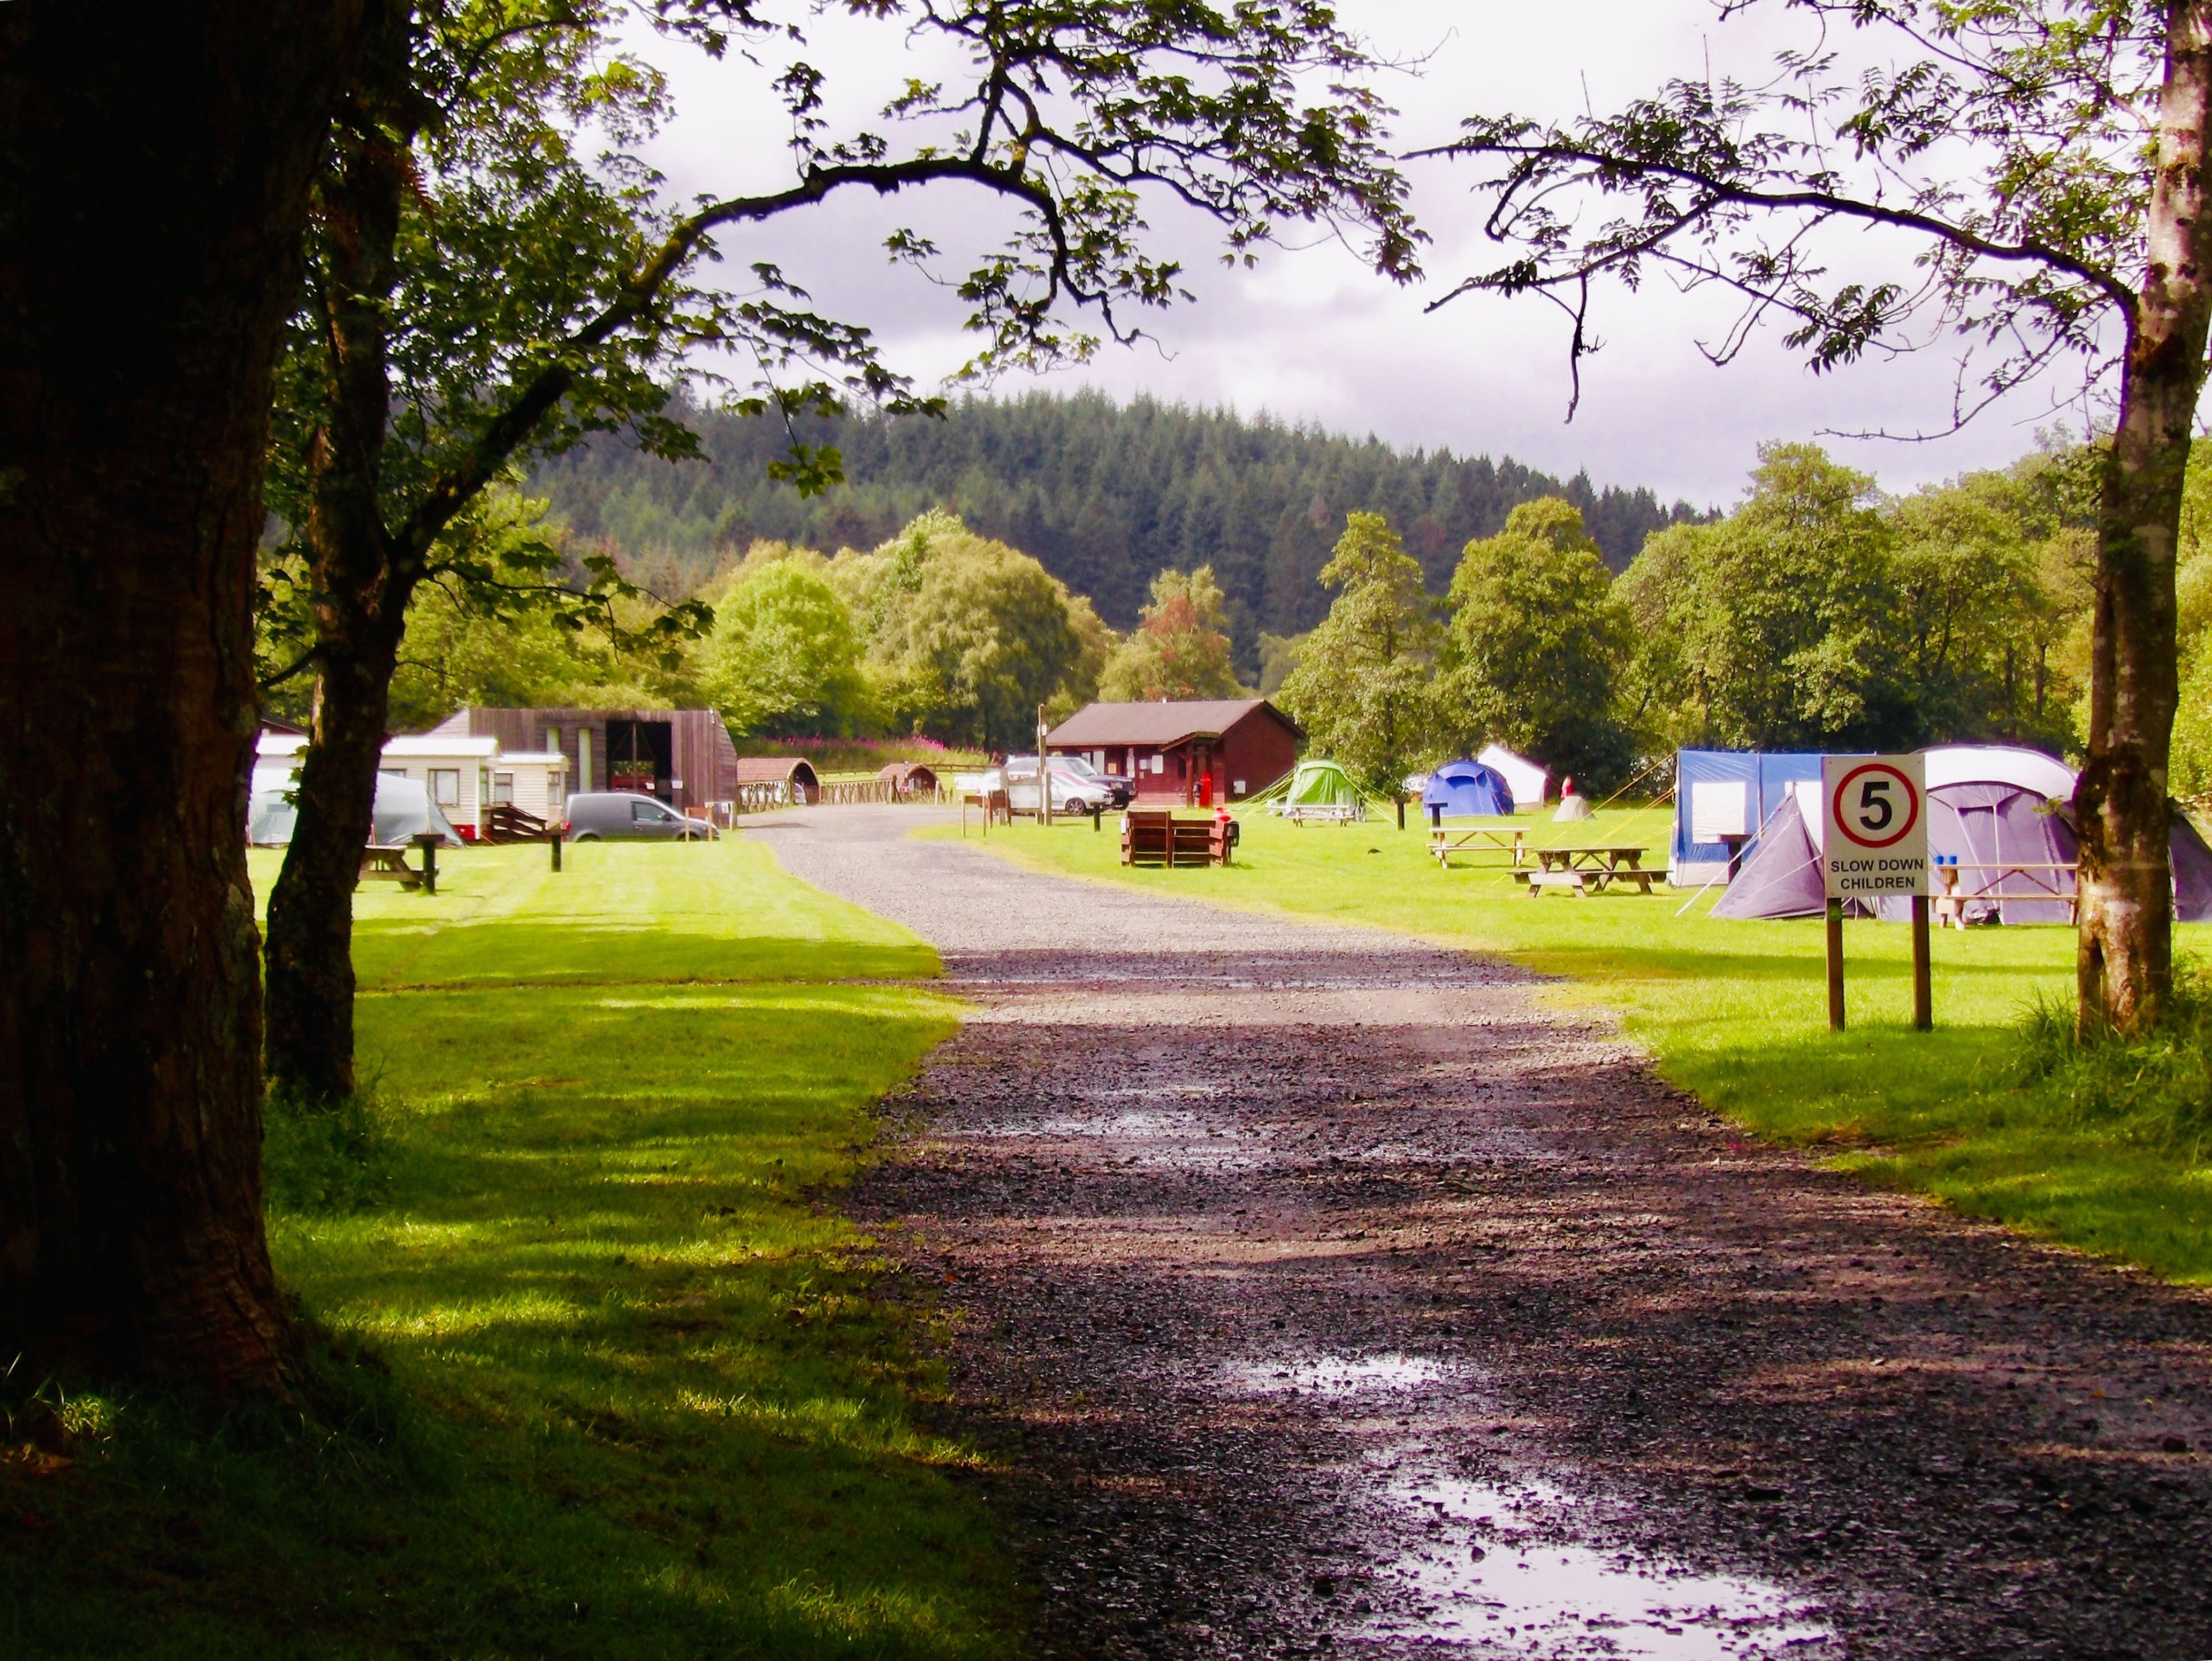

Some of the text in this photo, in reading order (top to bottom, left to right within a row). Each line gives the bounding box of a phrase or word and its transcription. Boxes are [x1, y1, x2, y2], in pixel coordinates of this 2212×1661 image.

[1860, 781, 1892, 830] 5
[1831, 859, 1923, 872] SLOW DOWN
[1841, 877, 1914, 889] CHILDREN
